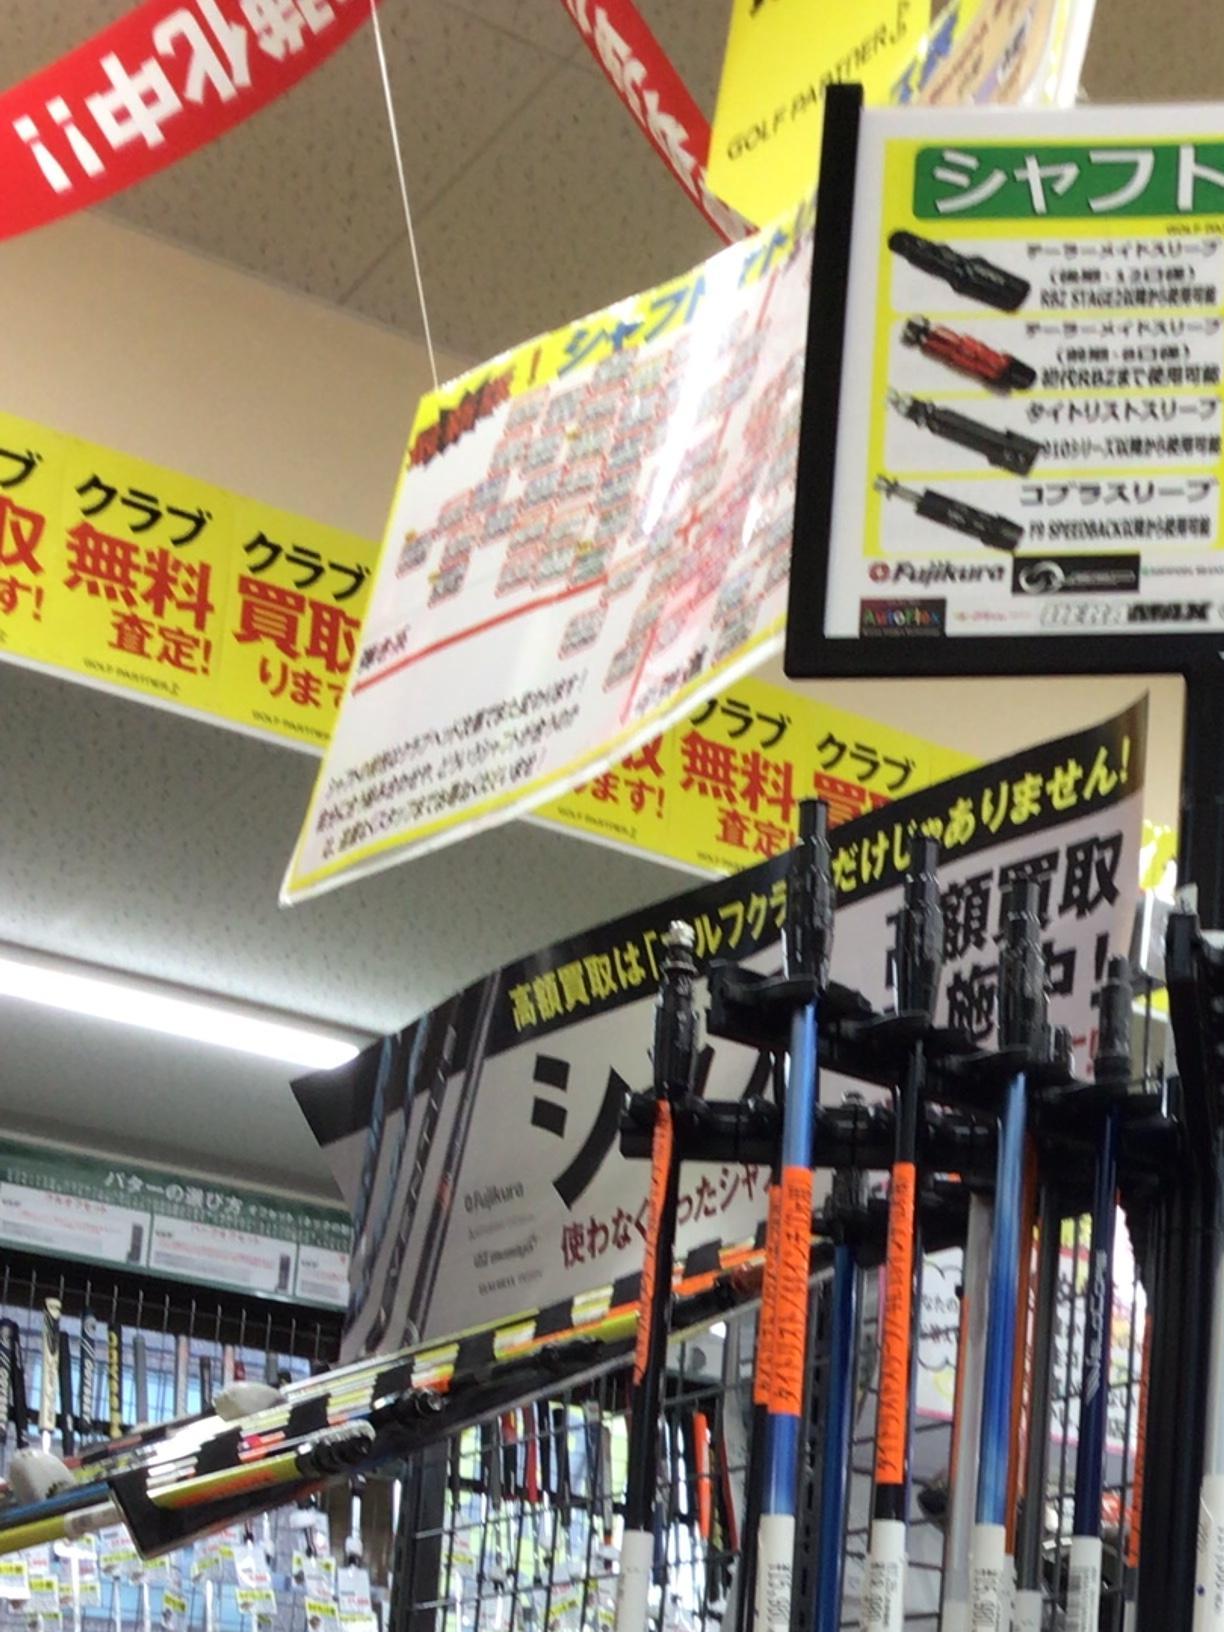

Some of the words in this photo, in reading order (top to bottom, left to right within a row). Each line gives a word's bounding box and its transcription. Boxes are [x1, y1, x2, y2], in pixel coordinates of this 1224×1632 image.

[76, 474, 213, 547] クラブ
[64, 521, 215, 632] 無料
[243, 531, 372, 601] クラブ
[892, 560, 1004, 587] Fujikura
[109, 609, 213, 677] 査定!
[575, 772, 666, 819] ます!
[681, 730, 797, 823] 無料
[816, 733, 917, 792] クラブ
[559, 1163, 772, 1269] 使わなくったシャ
